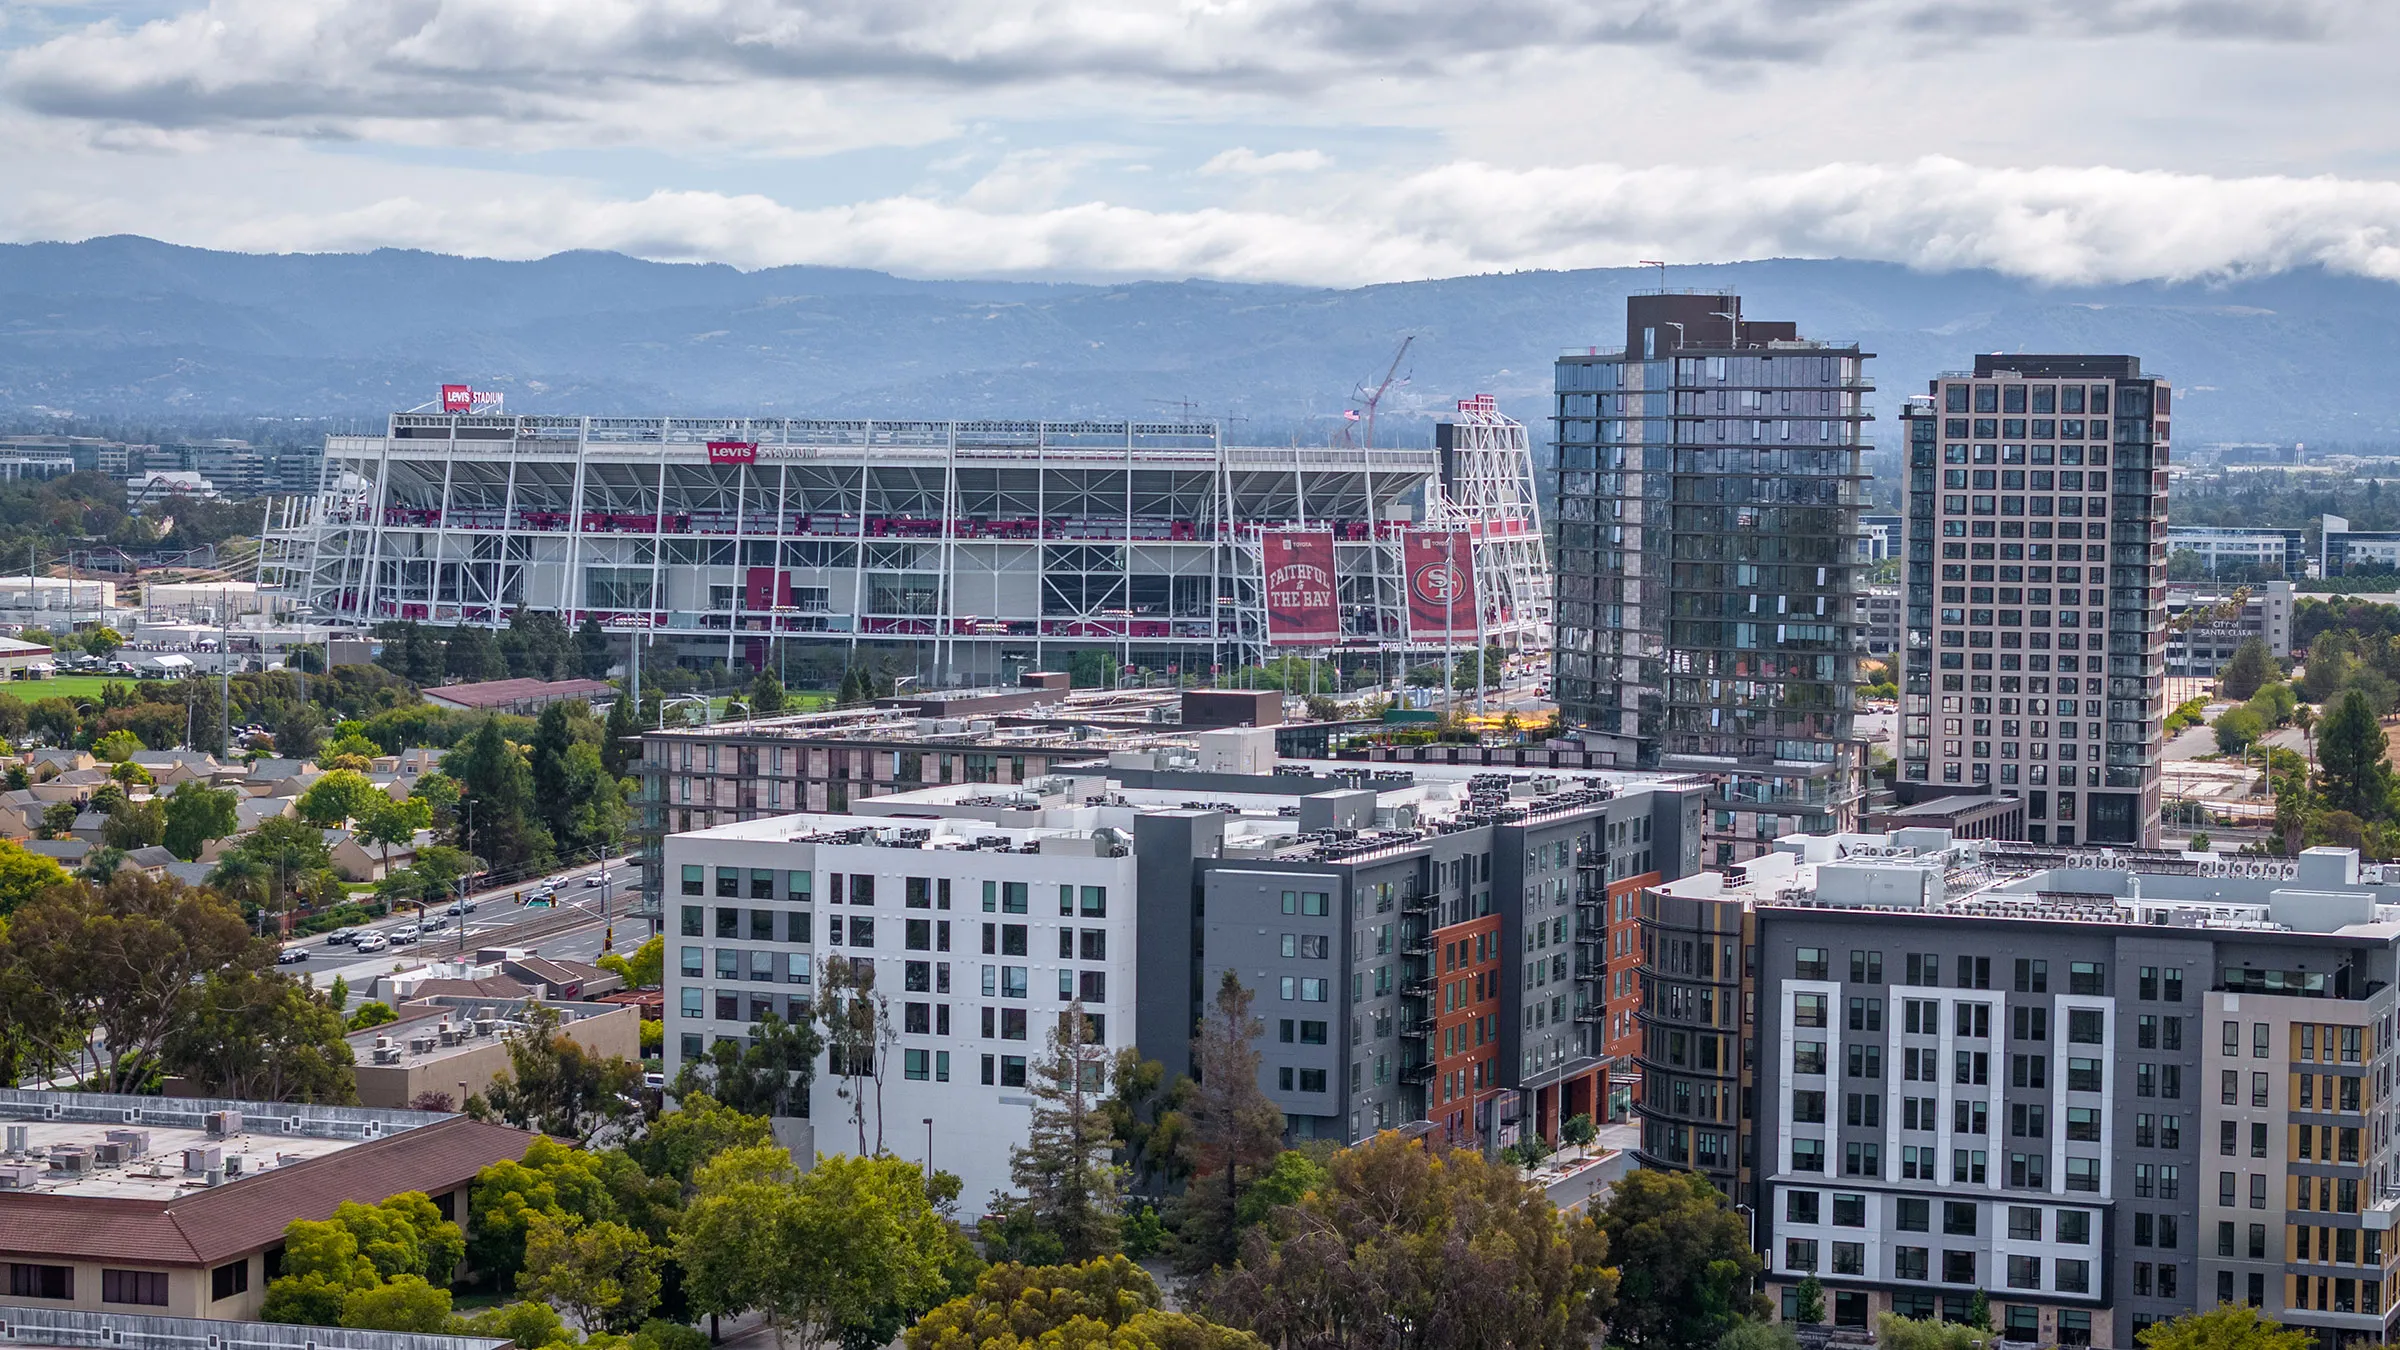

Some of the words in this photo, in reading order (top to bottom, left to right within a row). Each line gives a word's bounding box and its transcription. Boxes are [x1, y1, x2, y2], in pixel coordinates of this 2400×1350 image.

[472, 391, 504, 404] STADIUM
[760, 447, 818, 459] STADIUM
[1269, 564, 1331, 590] FAITHFUL
[1296, 580, 1304, 590] to
[1271, 591, 1300, 607] THE
[1303, 591, 1331, 607] BAY
